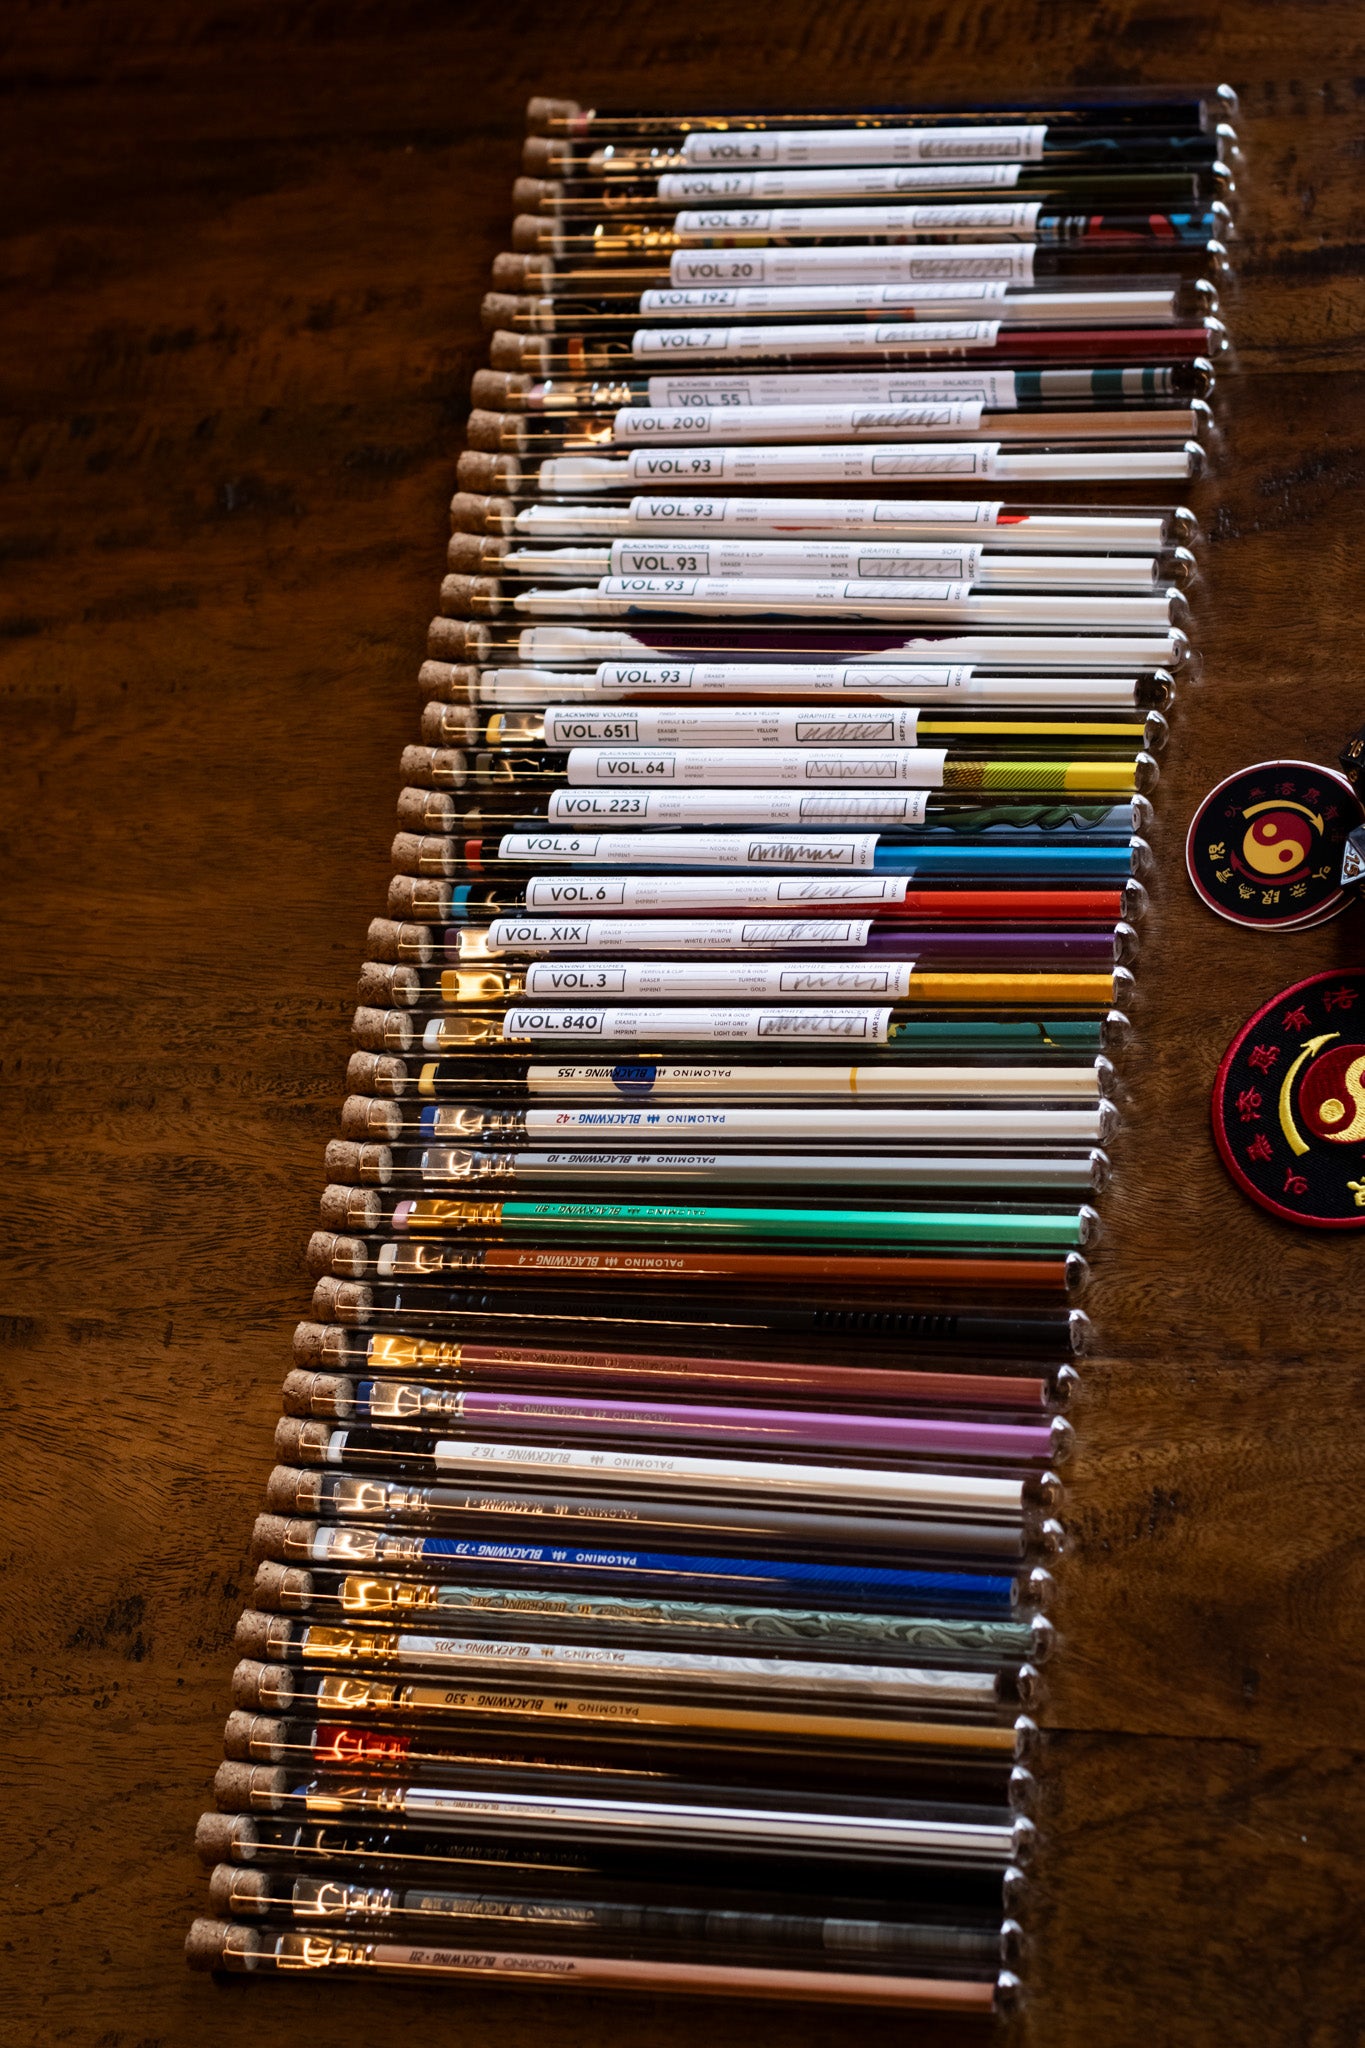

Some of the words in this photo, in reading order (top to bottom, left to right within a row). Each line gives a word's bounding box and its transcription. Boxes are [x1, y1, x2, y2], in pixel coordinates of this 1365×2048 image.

[752, 145, 761, 158] 2
[732, 263, 753, 277] 20
[702, 292, 729, 304] 192
[702, 334, 711, 347] 7
[721, 394, 742, 406] 55
[673, 416, 706, 430] 200
[647, 460, 688, 473] VOL.
[691, 460, 711, 473] 93
[650, 504, 690, 517] VOL.
[694, 504, 713, 517] 93
[632, 556, 674, 571] VOL.
[676, 556, 697, 571] 93
[621, 579, 660, 591] VOL.
[664, 579, 685, 591] 93
[615, 670, 656, 684] VOL.
[659, 670, 681, 683] 93
[561, 725, 601, 738] VOL.
[604, 725, 630, 738] 651
[607, 761, 643, 774] VOL.
[646, 761, 665, 774] 64
[565, 799, 606, 813] VOL.
[608, 799, 640, 812] 223
[527, 838, 567, 851] VOL.
[570, 839, 580, 851] 6
[551, 887, 593, 901] VOL.
[596, 886, 606, 900] 6
[505, 927, 547, 941] VOL.
[549, 926, 582, 940] XIX
[551, 973, 593, 988] VOL.
[596, 973, 606, 987] 3
[517, 1015, 559, 1029] VOL.
[562, 1015, 598, 1029] 840
[557, 1068, 575, 1077] 155
[585, 1068, 647, 1078] BLACKWING
[673, 1069, 731, 1078] PALOMINO
[556, 1113, 571, 1124] 42
[578, 1113, 641, 1124] BLACKWING
[667, 1115, 726, 1123] PALOMINO
[547, 1154, 561, 1163] 10
[567, 1154, 631, 1164] BLACKWING
[657, 1156, 716, 1164] PALOMINO
[557, 1205, 622, 1216] BLACKWING
[518, 1254, 526, 1265] 4
[536, 1254, 600, 1267] BLACKWING
[624, 1258, 684, 1268] PALOMINO
[471, 1445, 496, 1457] 16.2
[507, 1448, 571, 1464] BLACKWING
[614, 1457, 674, 1470] PALOMINO
[578, 1505, 639, 1520] PALOMINO
[455, 1542, 470, 1555] 73
[477, 1544, 543, 1561] BLACKWING
[576, 1553, 637, 1567] PALOMINO
[464, 1642, 531, 1657] BLACKWING
[445, 1692, 468, 1704] 530
[477, 1694, 545, 1710] BLACKWING
[577, 1703, 639, 1716] PALOMINO
[432, 1953, 497, 1968] BLACKWING
